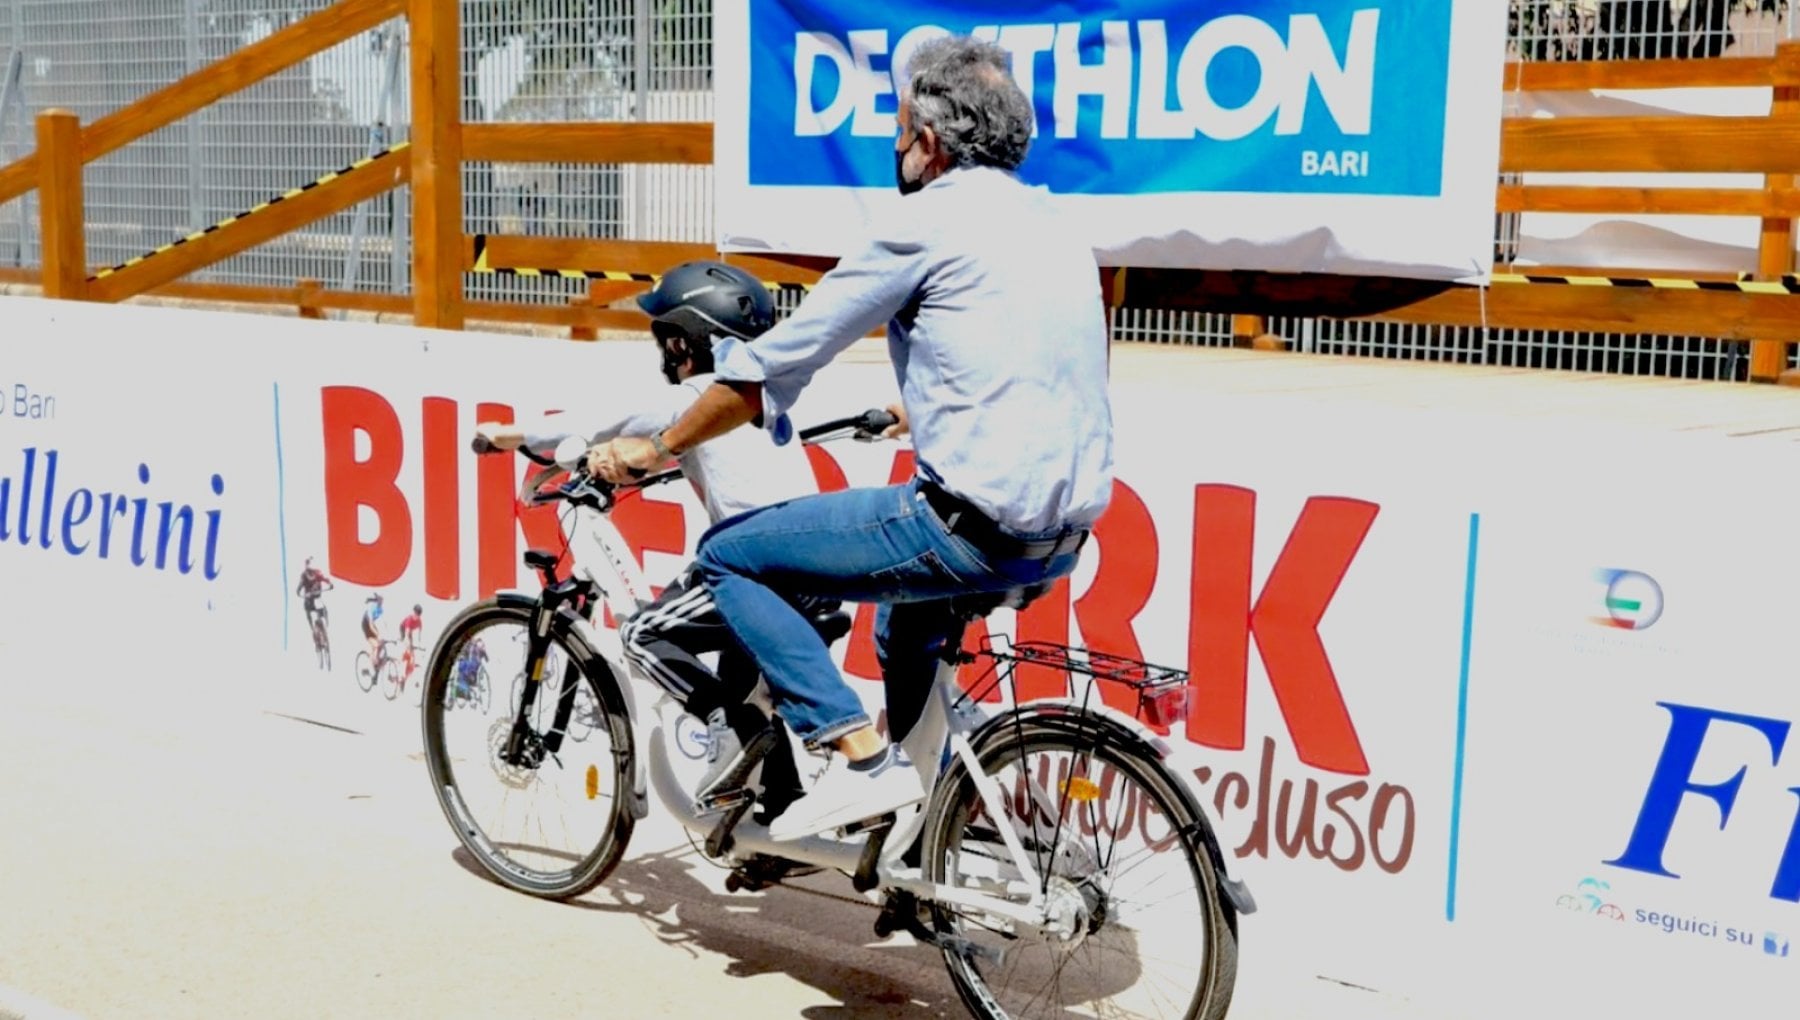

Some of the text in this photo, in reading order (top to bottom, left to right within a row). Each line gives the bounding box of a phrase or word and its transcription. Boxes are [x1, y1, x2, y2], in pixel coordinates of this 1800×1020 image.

[794, 8, 1381, 140] DETHLON
[1301, 150, 1369, 177] BARI
[1634, 907, 1754, 946] seguici su
